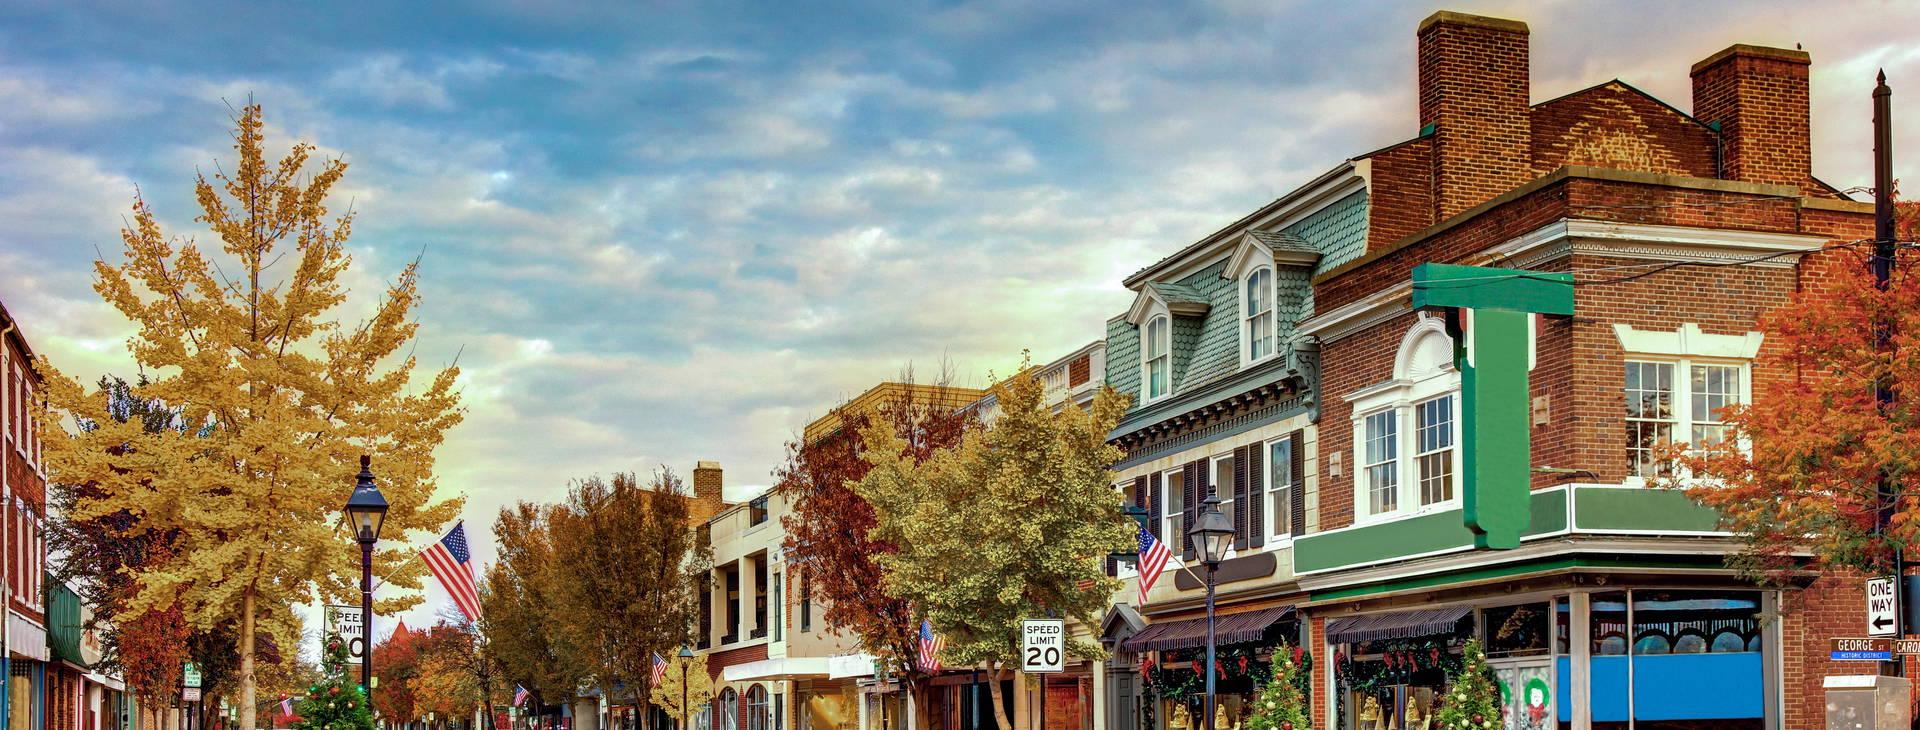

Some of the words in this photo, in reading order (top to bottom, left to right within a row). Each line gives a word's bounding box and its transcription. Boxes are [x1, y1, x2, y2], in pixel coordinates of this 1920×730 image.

[1871, 581, 1892, 597] ONE
[1872, 598, 1893, 613] WAY
[331, 613, 364, 622] PEE
[339, 624, 364, 634] IMIT
[1027, 625, 1060, 634] SPEED
[1029, 636, 1056, 645] LIMIT
[1838, 640, 1874, 651] GEORGE
[1027, 647, 1060, 666] 20
